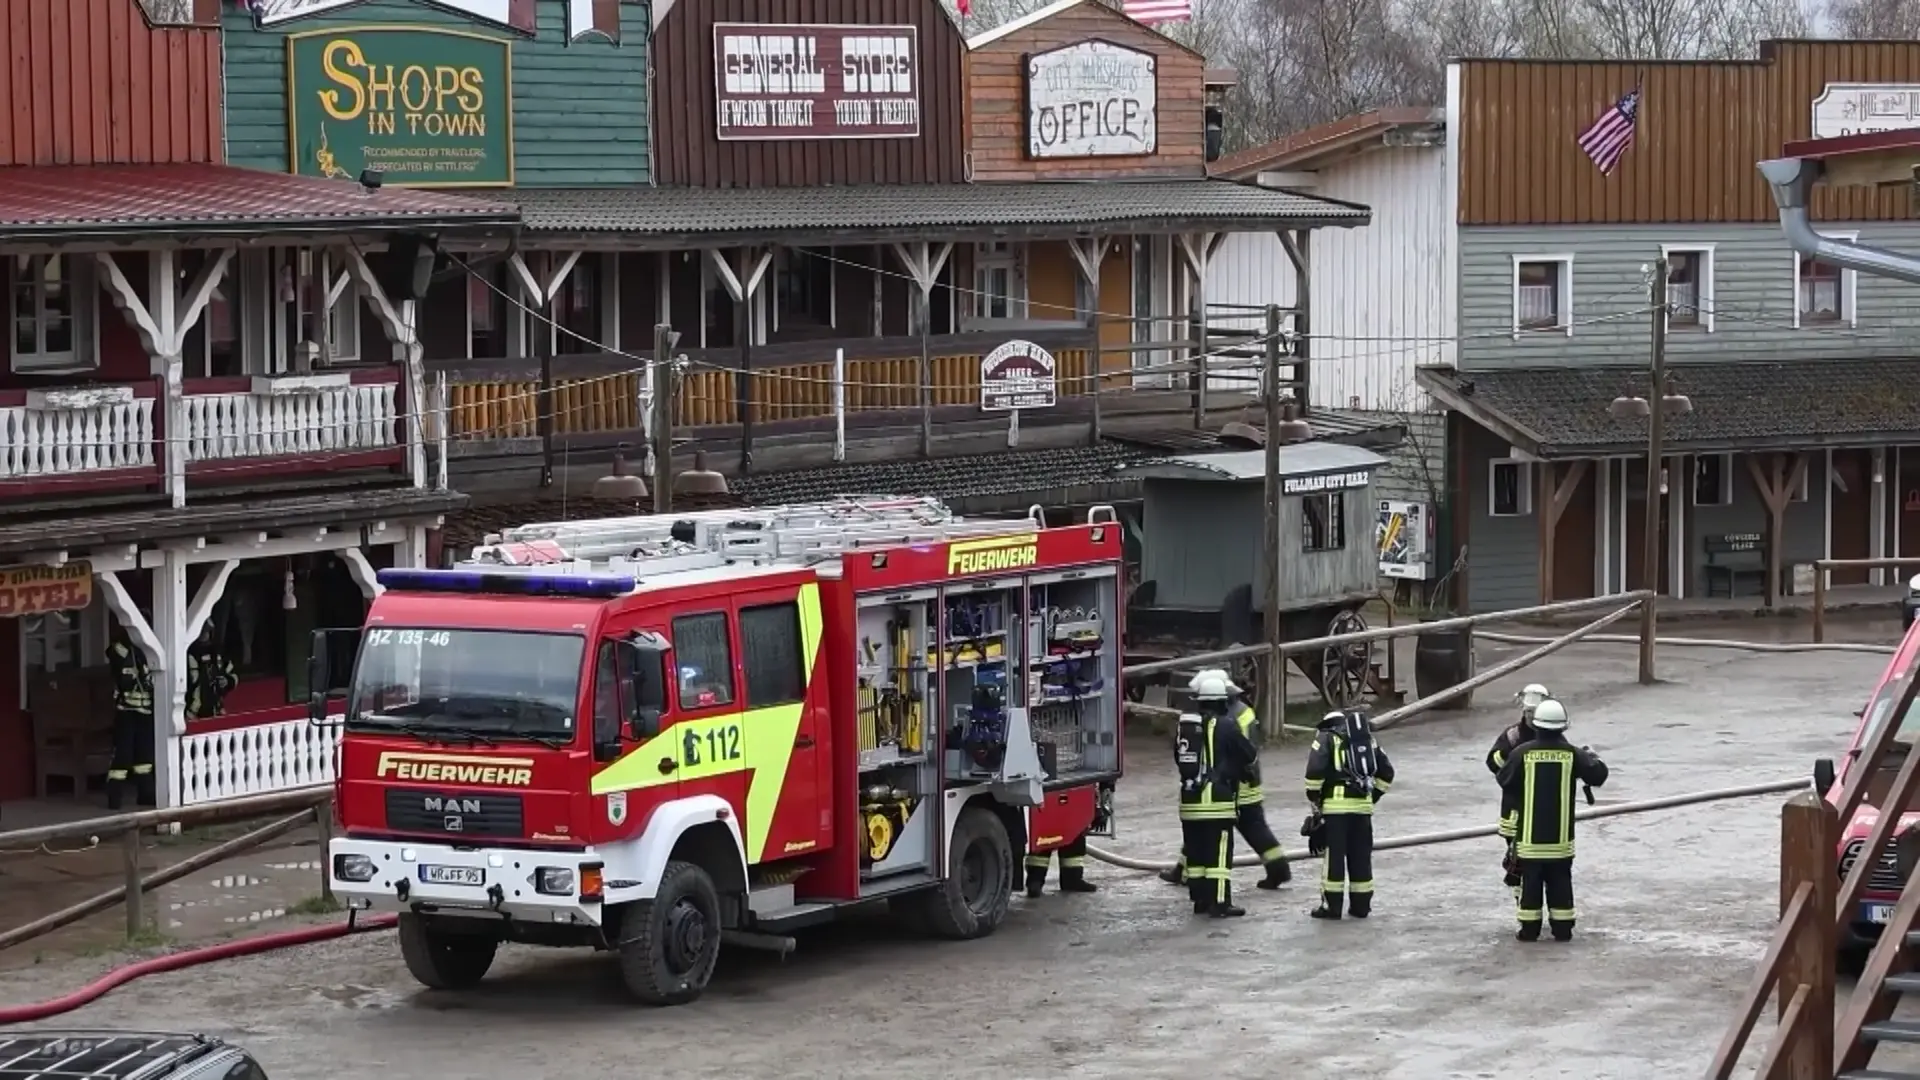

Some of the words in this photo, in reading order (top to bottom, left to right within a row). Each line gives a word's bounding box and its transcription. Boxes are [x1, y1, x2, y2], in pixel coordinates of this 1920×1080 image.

[317, 39, 484, 120] SHOPS
[723, 36, 825, 93] GENERAL
[842, 37, 911, 93] STORE
[368, 112, 395, 135] IN
[405, 112, 486, 137] TOWN
[1038, 97, 1144, 147] OFFICE
[1326, 474, 1345, 488] CITY
[948, 534, 1038, 575] FEUERWEHR
[368, 630, 393, 646] HZ
[398, 630, 450, 646] 135-46
[706, 725, 740, 762] 112
[377, 751, 534, 785] FEUERWEHR
[425, 797, 481, 813] MAN
